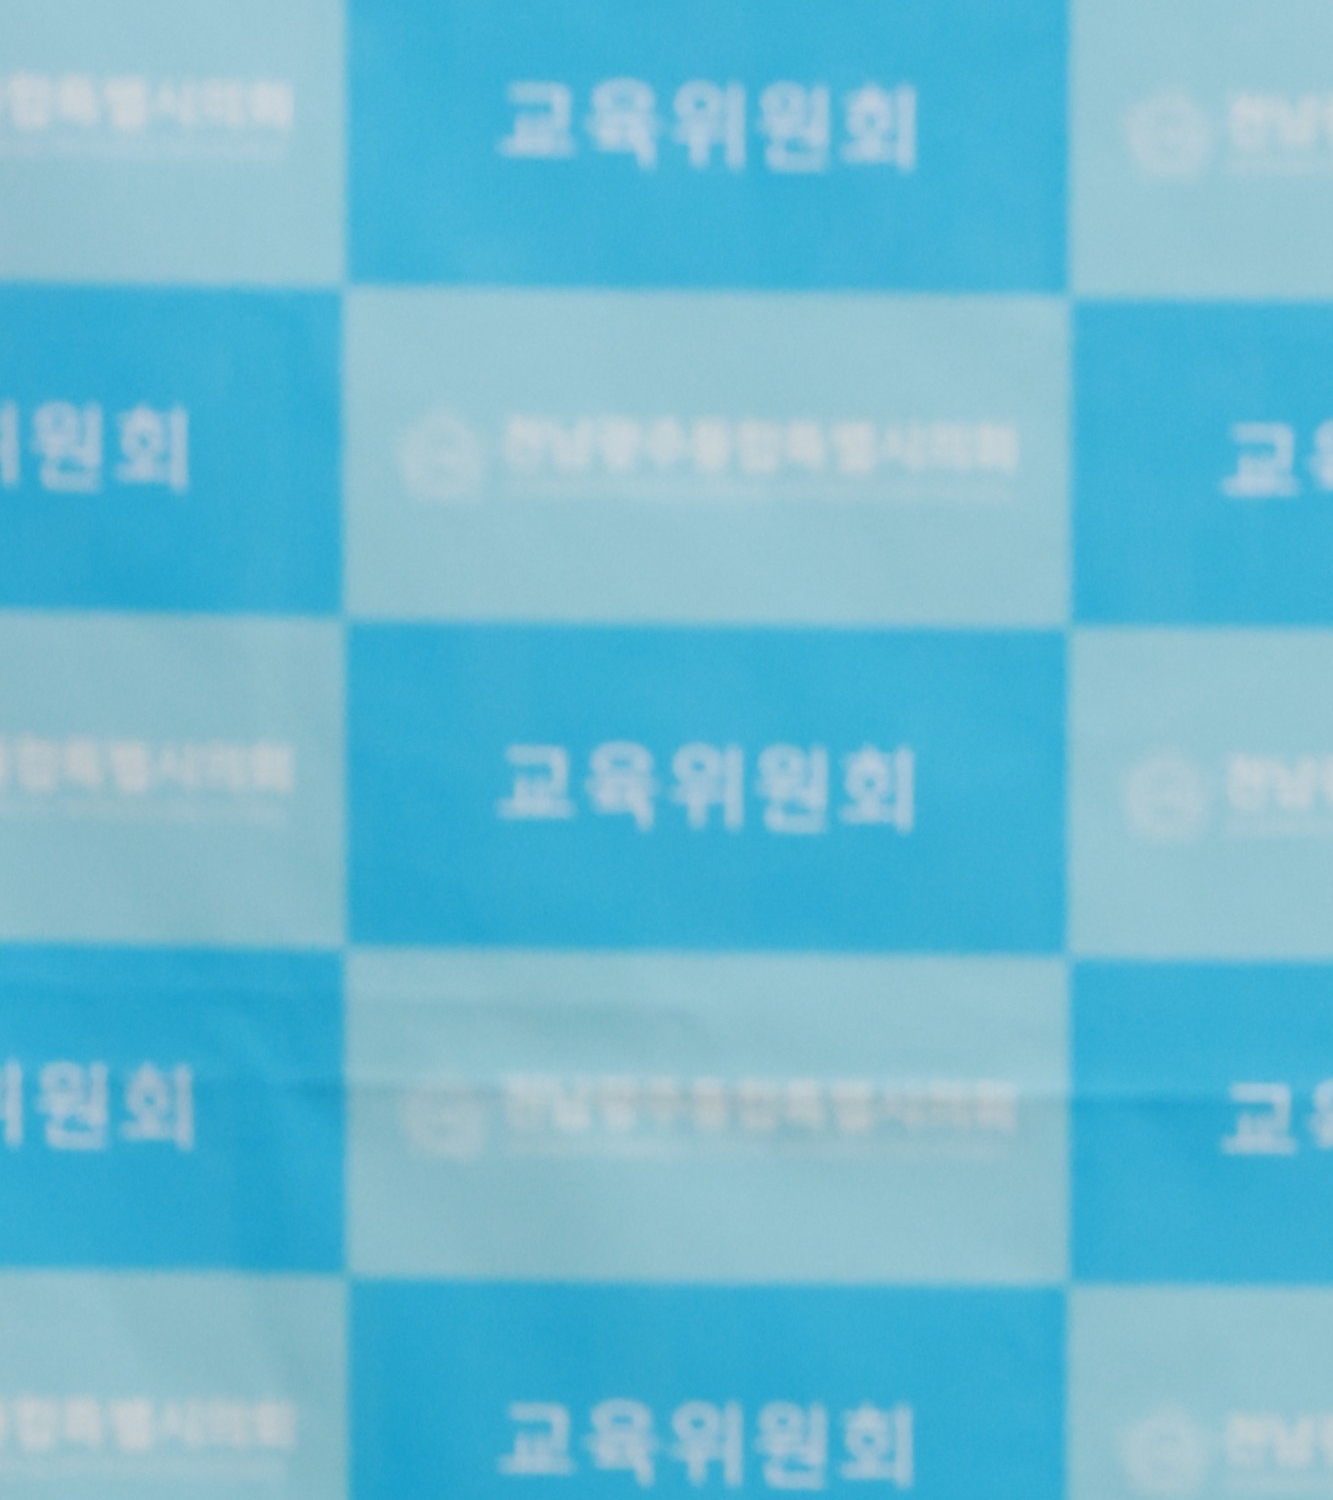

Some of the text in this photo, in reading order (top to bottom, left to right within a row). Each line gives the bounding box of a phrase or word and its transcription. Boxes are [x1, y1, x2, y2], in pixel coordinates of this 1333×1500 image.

[499, 75, 919, 175] 교육위원회
[0, 399, 191, 495] 원회
[497, 739, 917, 837] 교육위원회
[0, 1057, 197, 1153] 원회
[497, 1395, 917, 1493] 교육위원회
